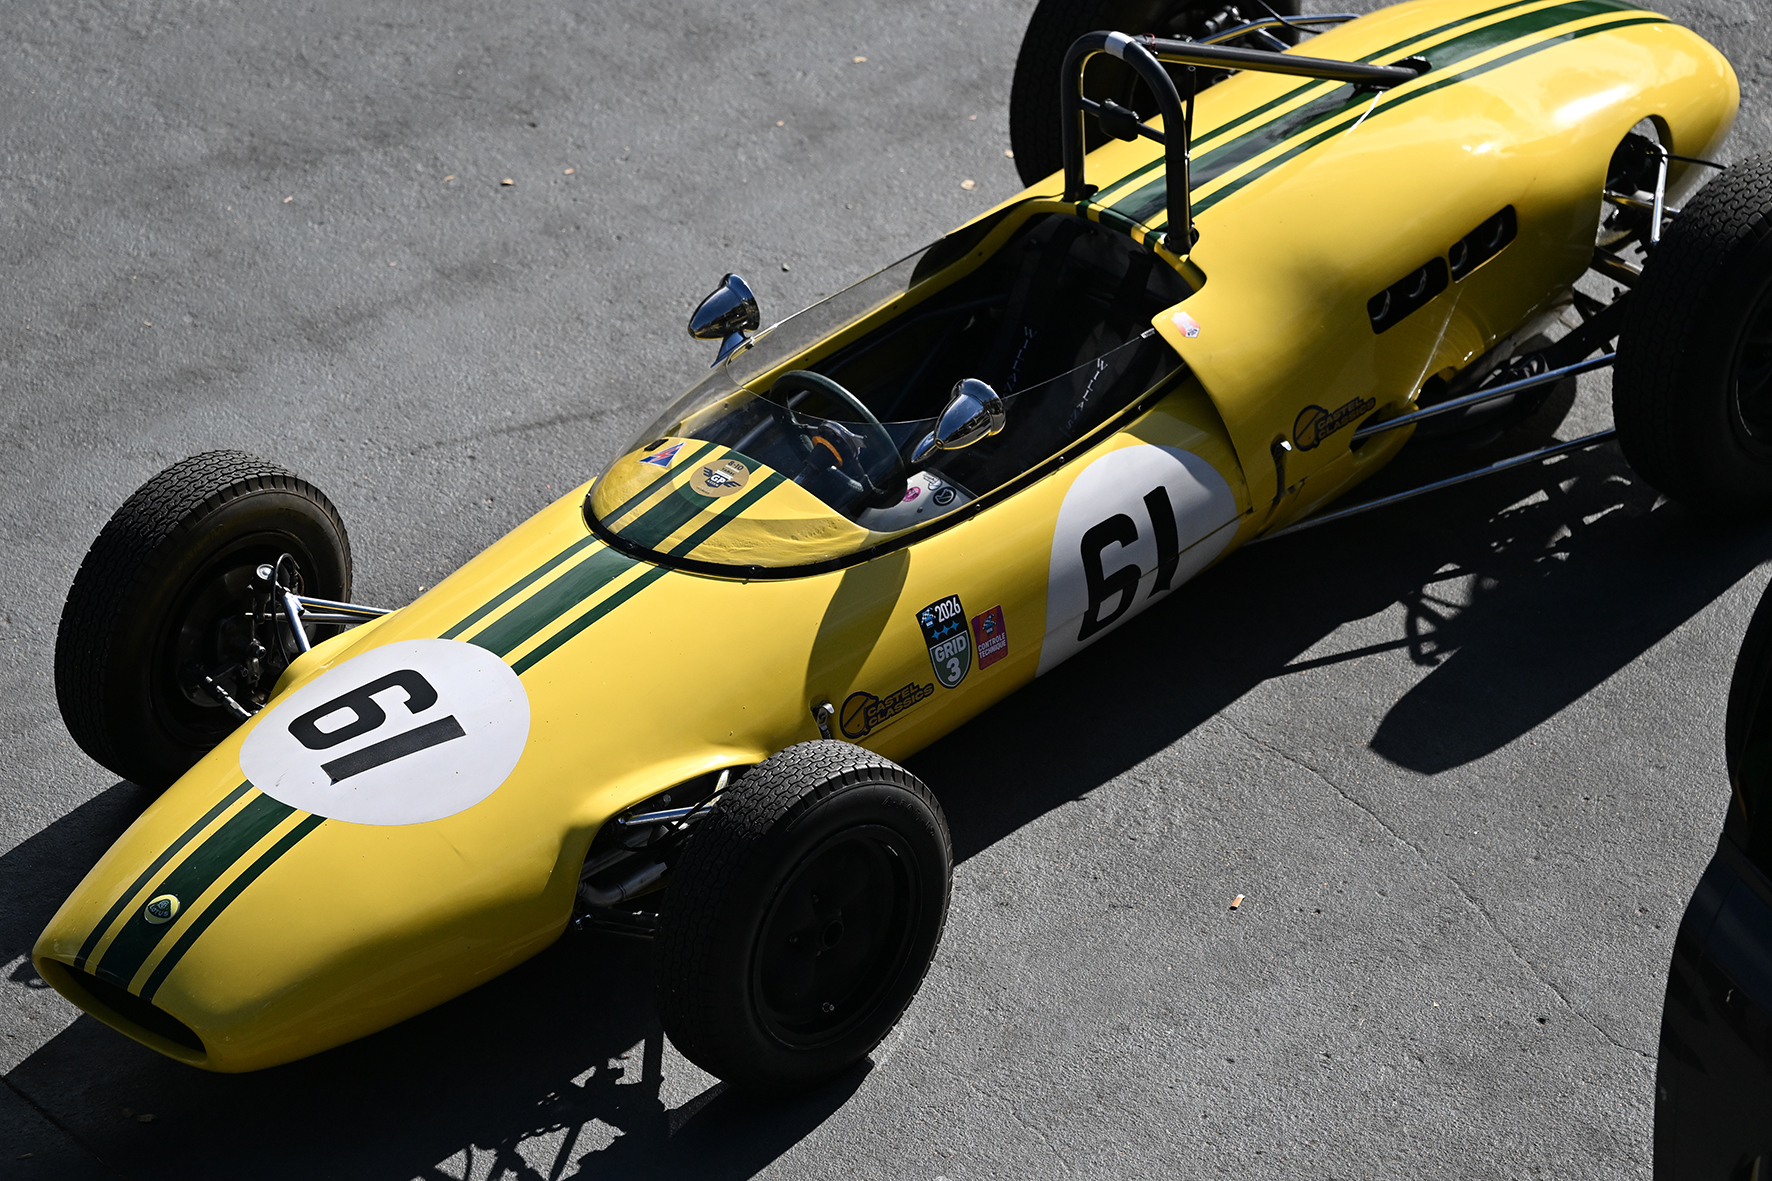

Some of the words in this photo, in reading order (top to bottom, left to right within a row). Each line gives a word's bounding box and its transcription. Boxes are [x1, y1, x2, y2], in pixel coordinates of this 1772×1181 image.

[1065, 358, 1108, 429] WILLANS
[1318, 399, 1363, 429] CASTEL
[1318, 399, 1375, 439] CLASSICS
[711, 474, 726, 484] GP
[1077, 485, 1180, 642] 61
[934, 597, 961, 623] 2026
[934, 635, 967, 662] GRID
[977, 632, 1006, 652] CONTROLE
[979, 640, 1007, 659] TECHNIQUE
[946, 657, 961, 682] 3
[867, 685, 918, 717] CASTEL
[868, 685, 933, 727] CLASSICS
[288, 669, 466, 786] 61
[149, 904, 168, 916] LOTUS
